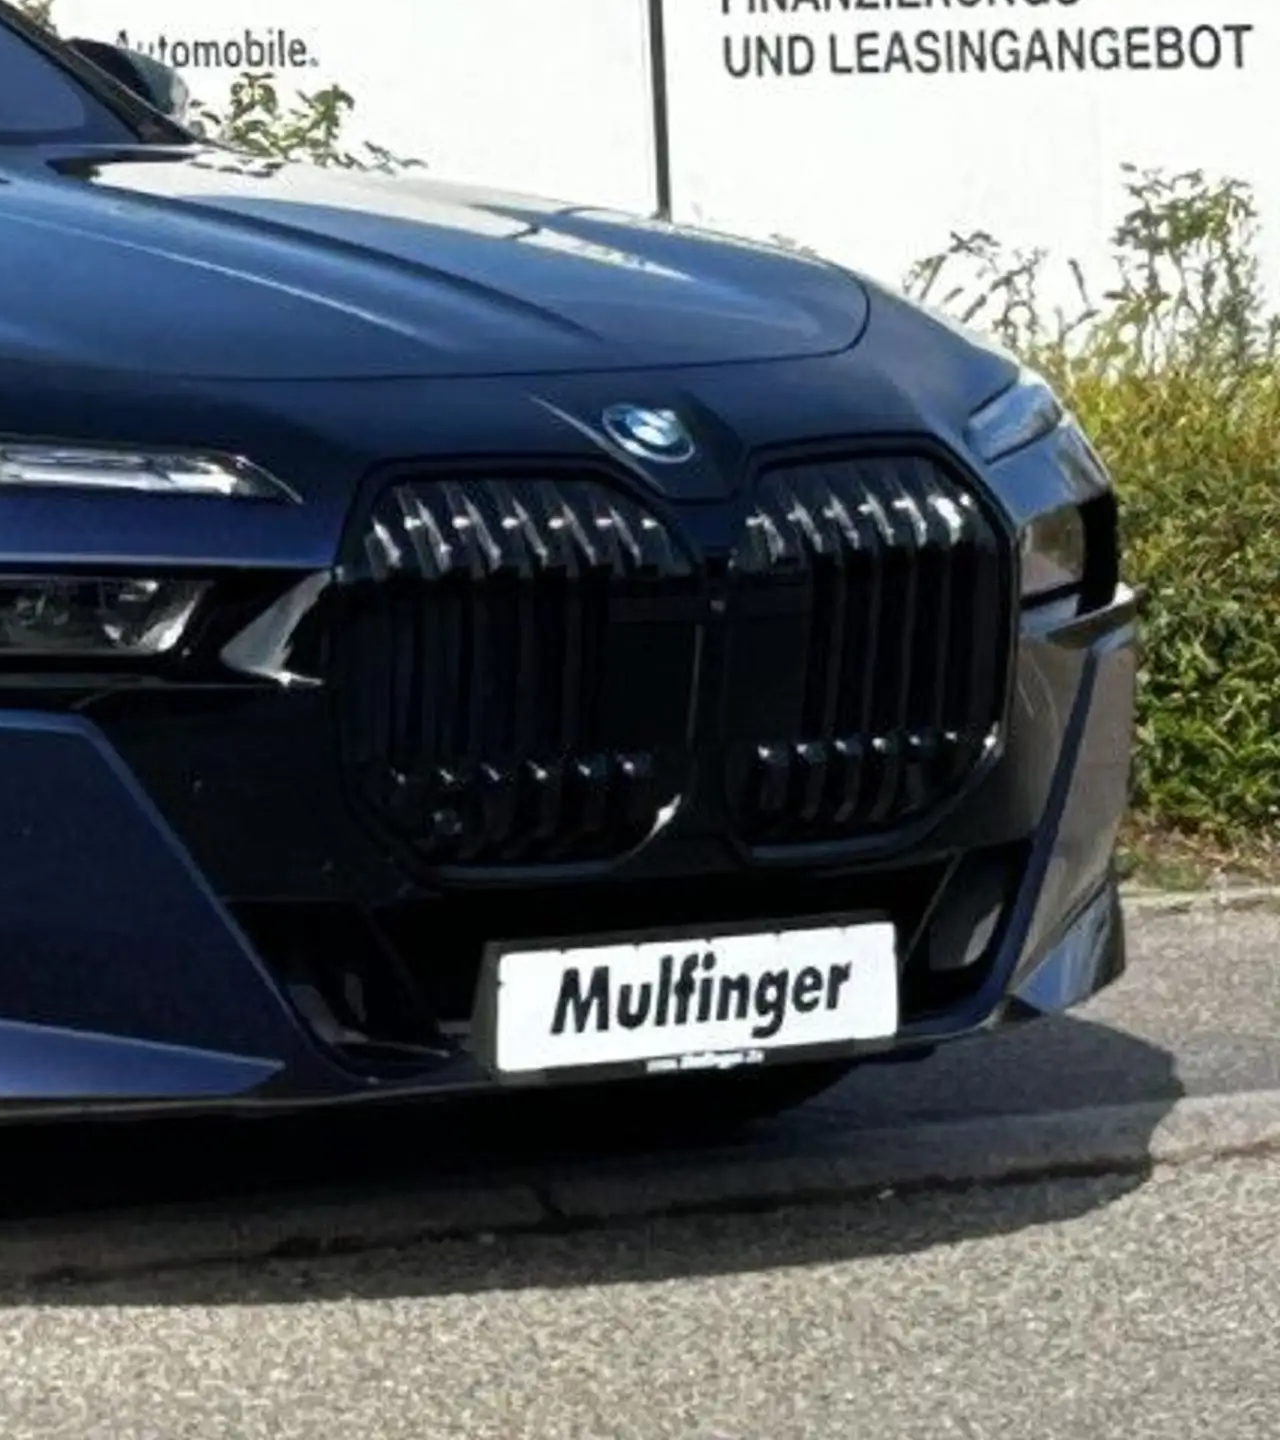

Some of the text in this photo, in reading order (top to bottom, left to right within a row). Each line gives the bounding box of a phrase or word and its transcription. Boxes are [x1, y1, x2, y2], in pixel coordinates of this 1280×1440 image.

[723, 24, 1254, 78] UND LEASINGANGEBOT
[550, 952, 852, 1039] Mulfinger
